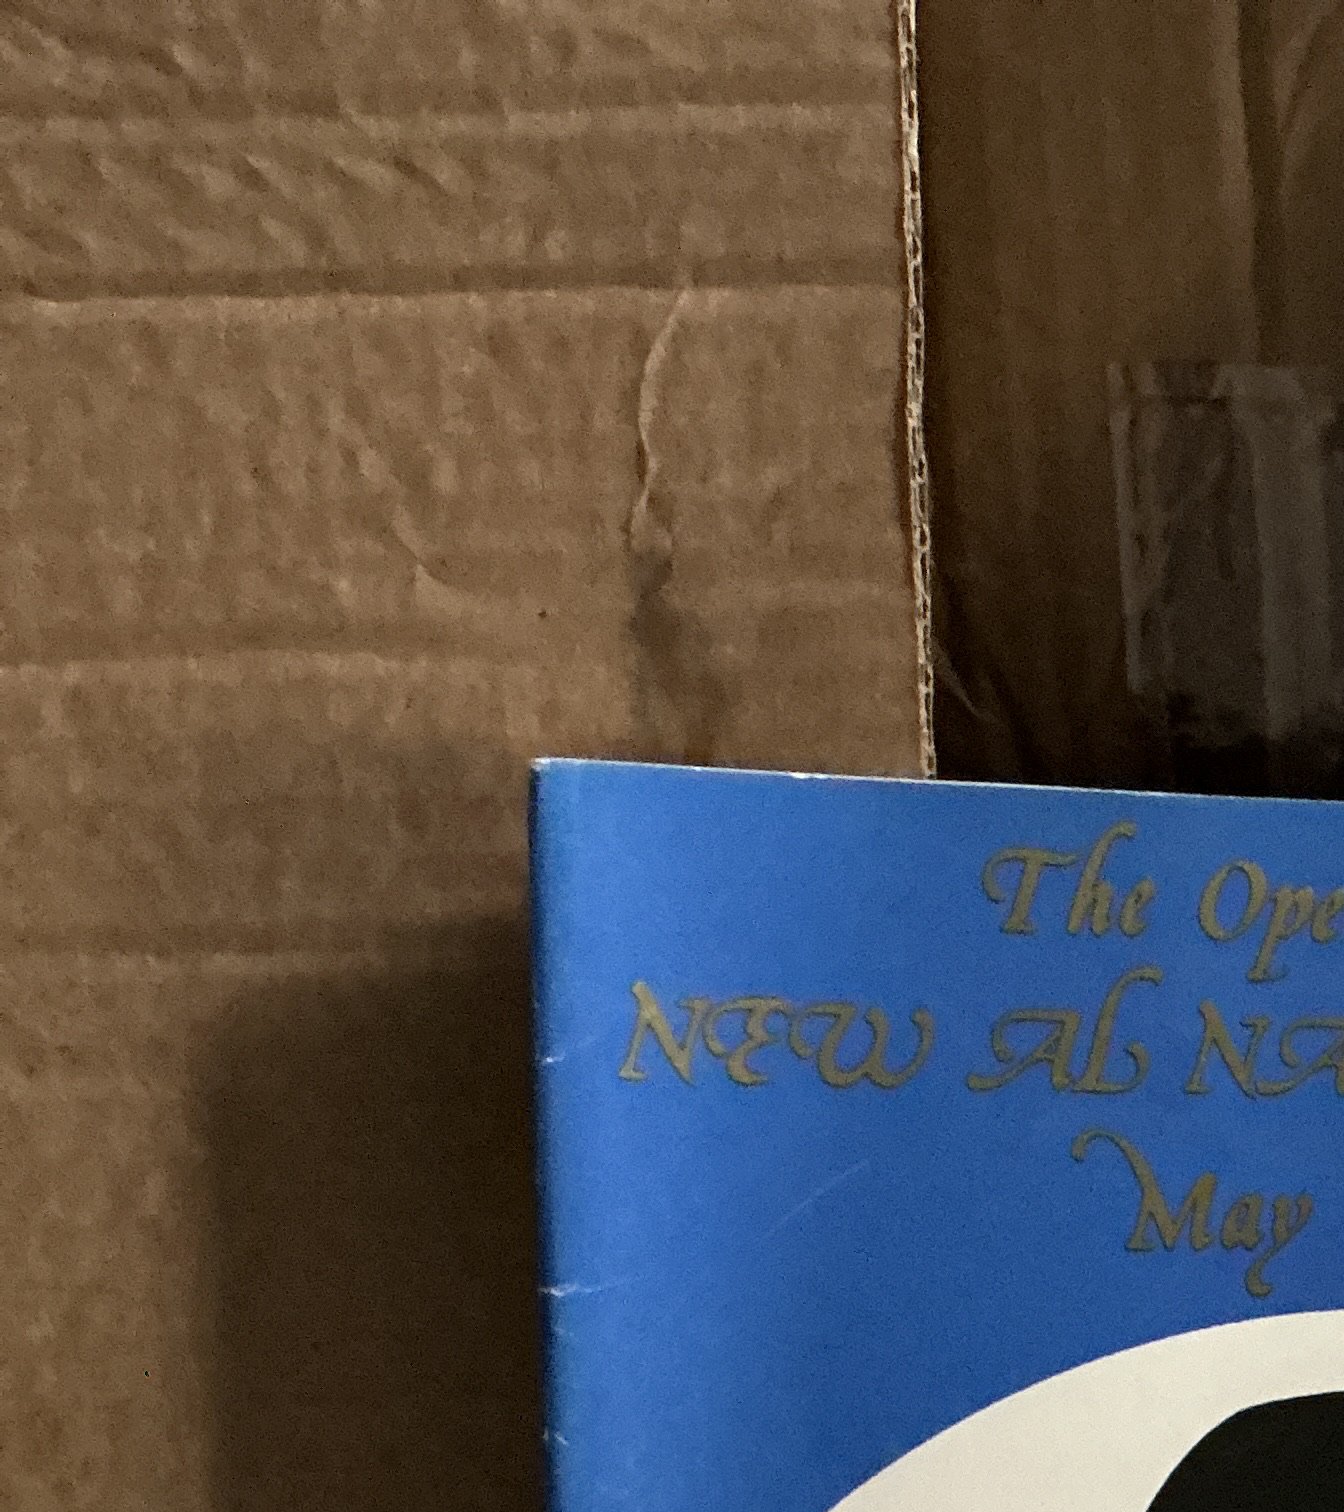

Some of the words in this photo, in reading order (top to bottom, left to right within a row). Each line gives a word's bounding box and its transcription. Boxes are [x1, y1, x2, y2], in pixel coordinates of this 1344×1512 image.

[982, 819, 1159, 937] The
[618, 979, 935, 1087] NEW
[1070, 1127, 1315, 1297] May
